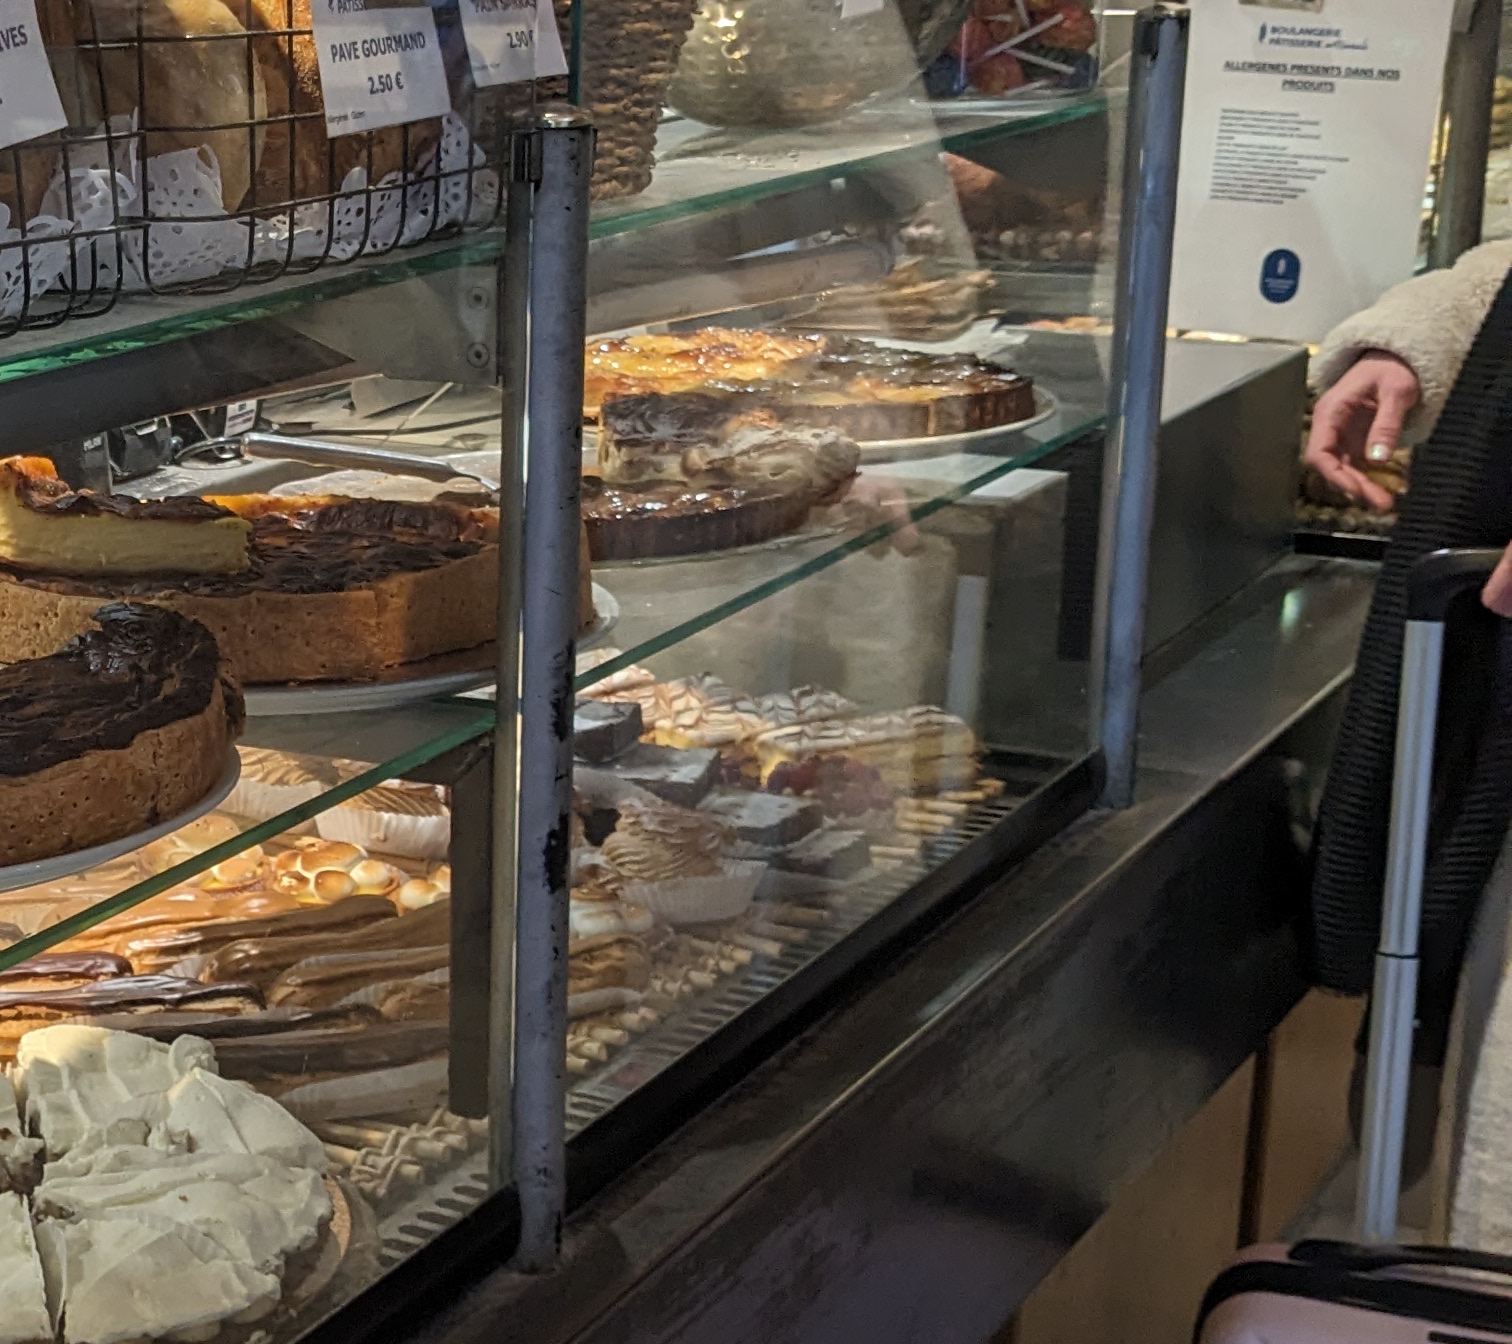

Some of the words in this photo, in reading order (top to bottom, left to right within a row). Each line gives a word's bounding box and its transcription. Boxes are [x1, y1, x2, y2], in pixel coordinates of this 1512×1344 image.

[330, 41, 360, 63] PAVE
[361, 31, 426, 58] GOURMAND
[506, 32, 528, 50] 2.90
[1224, 60, 1288, 74] ALLERGENES
[1290, 64, 1341, 77] PRESENTS
[1344, 67, 1374, 79] DANS
[1377, 69, 1401, 80] NOS
[368, 74, 393, 95] 2.50
[395, 72, 404, 90] €
[1282, 79, 1335, 92] PRODUITS
